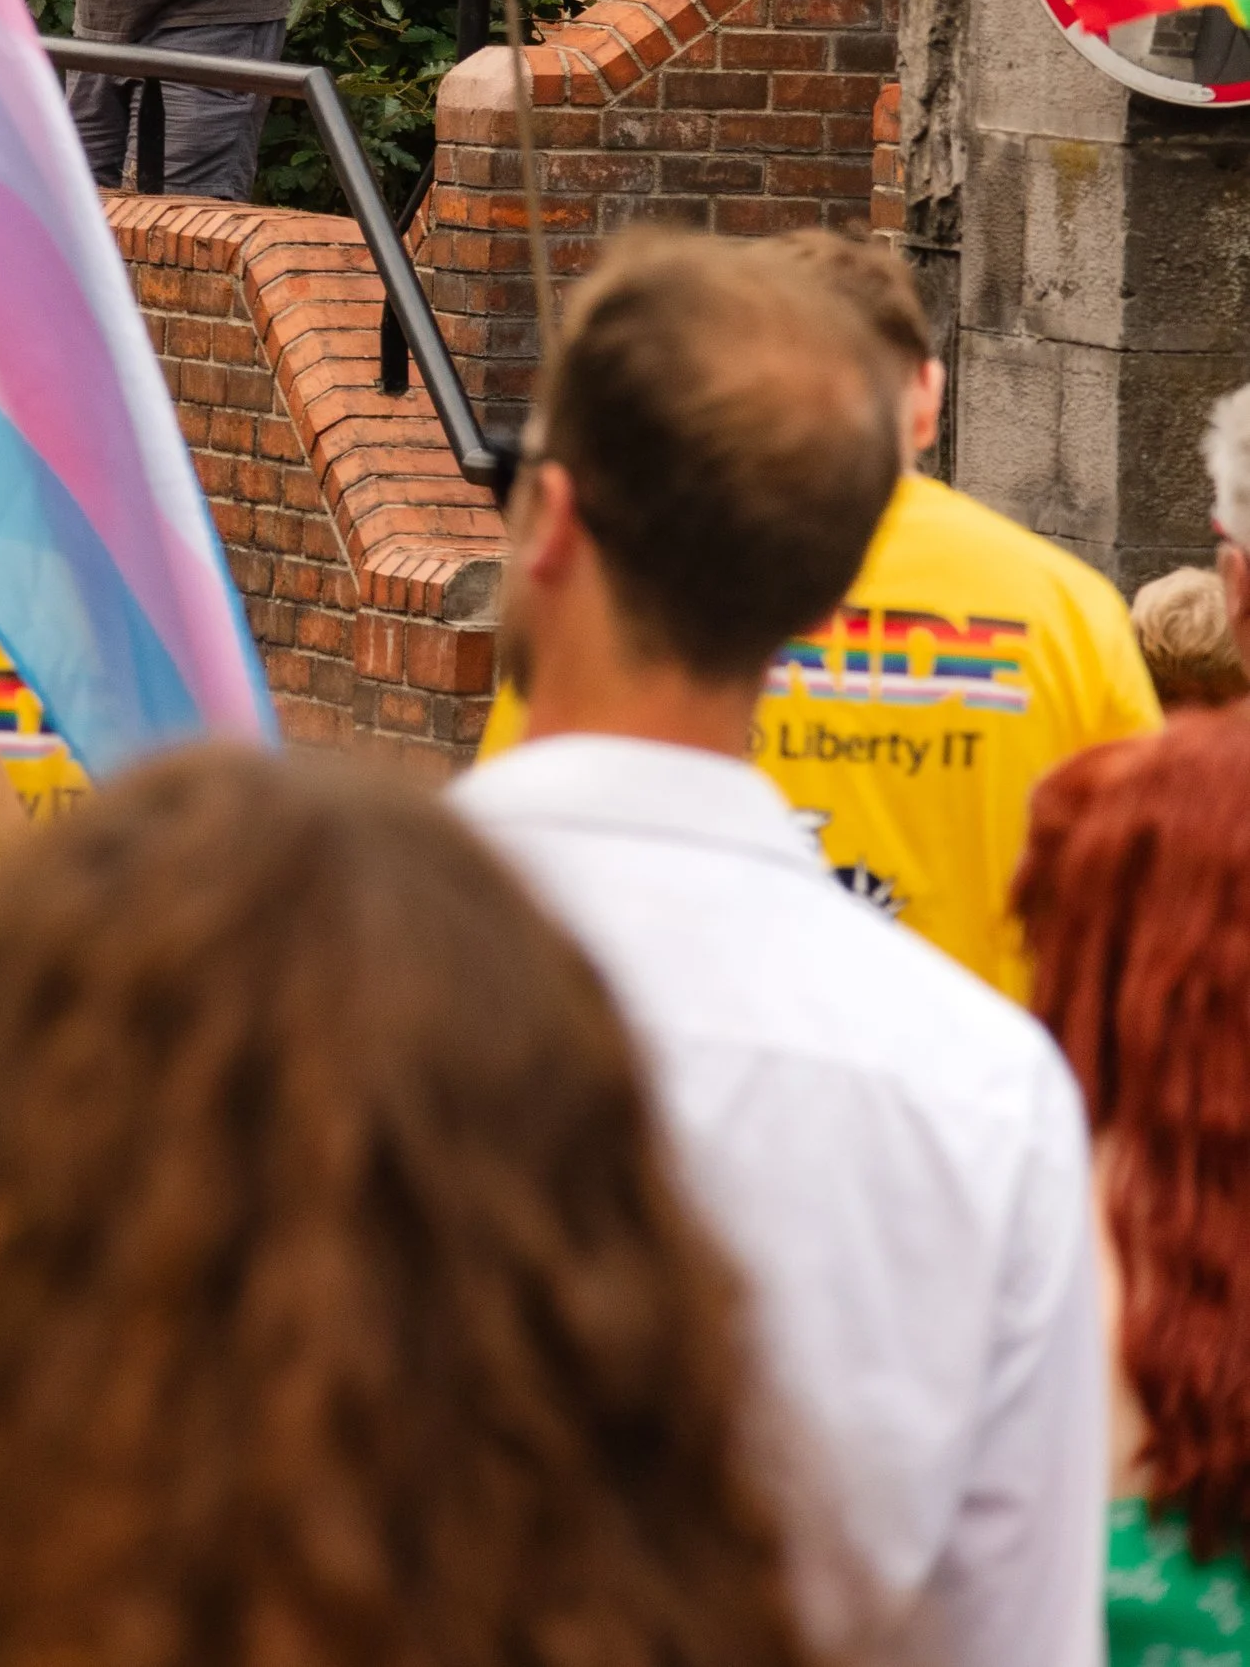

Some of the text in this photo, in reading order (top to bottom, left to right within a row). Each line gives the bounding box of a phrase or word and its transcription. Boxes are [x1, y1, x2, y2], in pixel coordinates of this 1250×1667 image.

[764, 608, 1030, 714] RIDE
[778, 721, 930, 776] Liberty
[941, 730, 984, 769] IT
